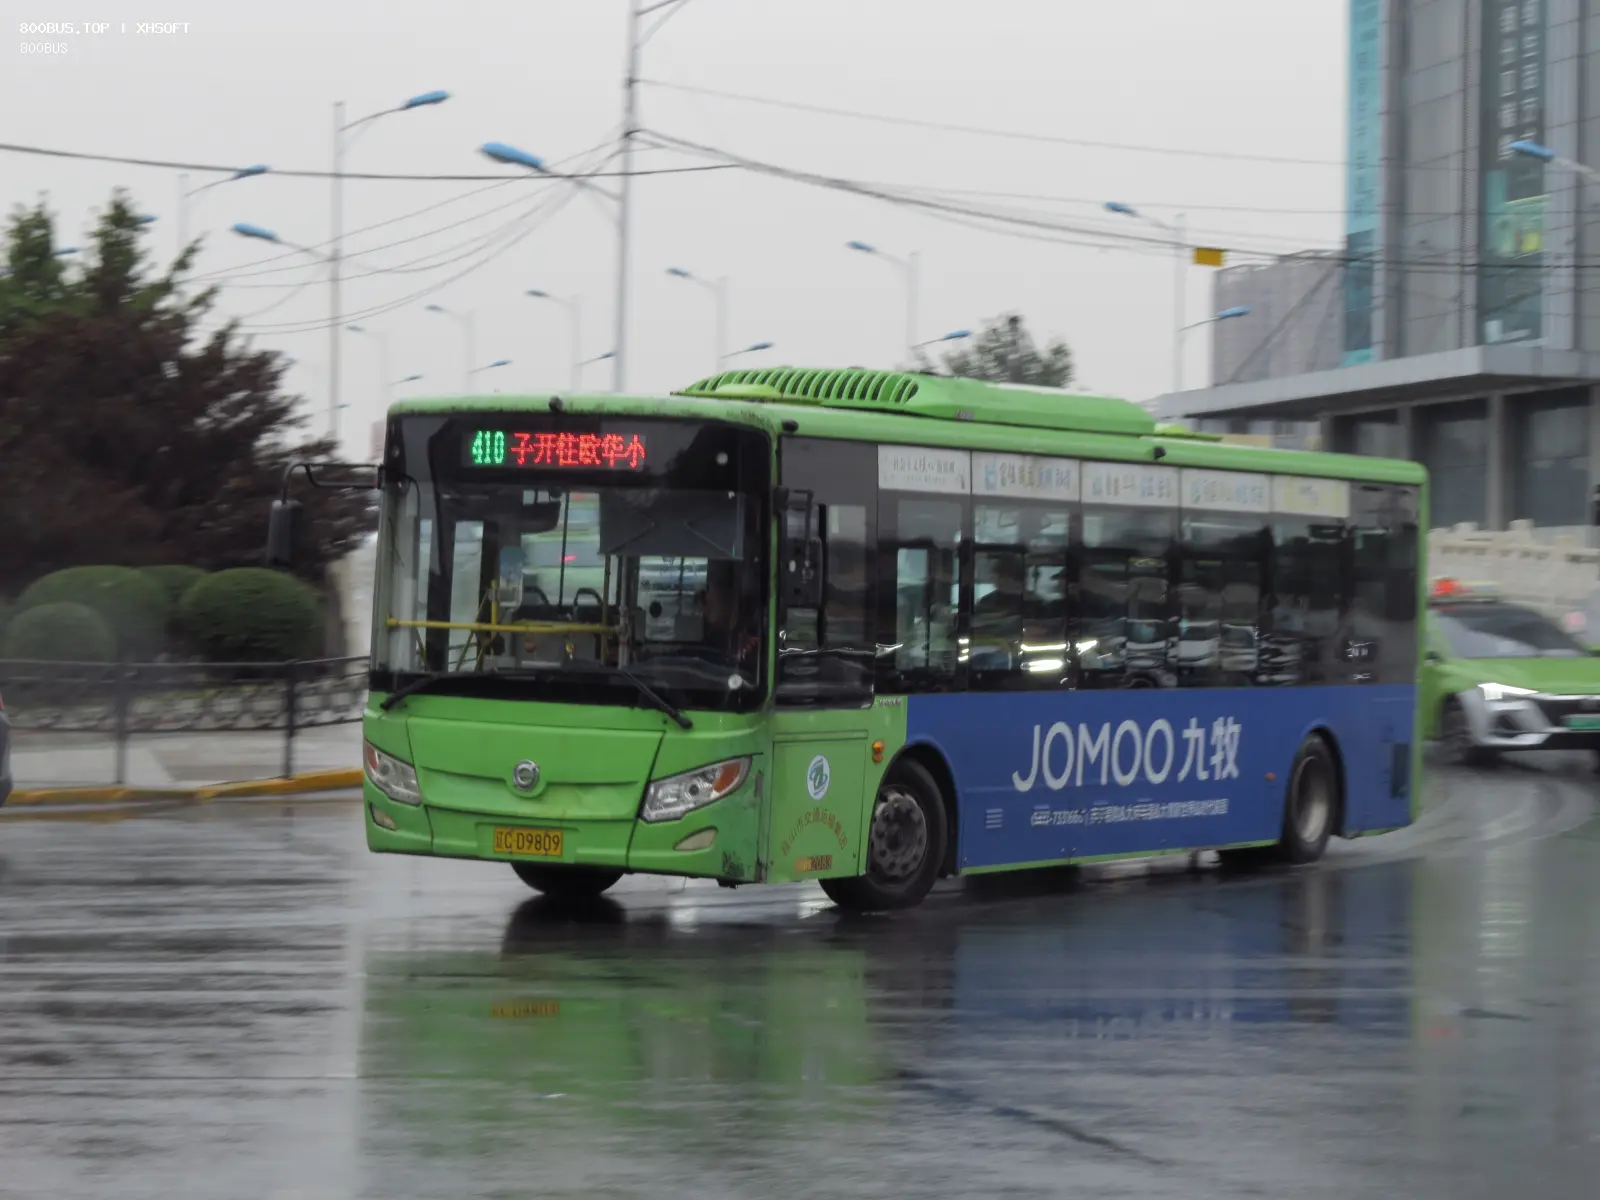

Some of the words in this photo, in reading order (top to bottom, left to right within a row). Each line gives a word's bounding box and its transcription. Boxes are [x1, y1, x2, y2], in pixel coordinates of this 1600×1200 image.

[472, 430, 505, 464] 410
[1012, 719, 1174, 792] JOMOO
[1177, 716, 1242, 783] 九牧
